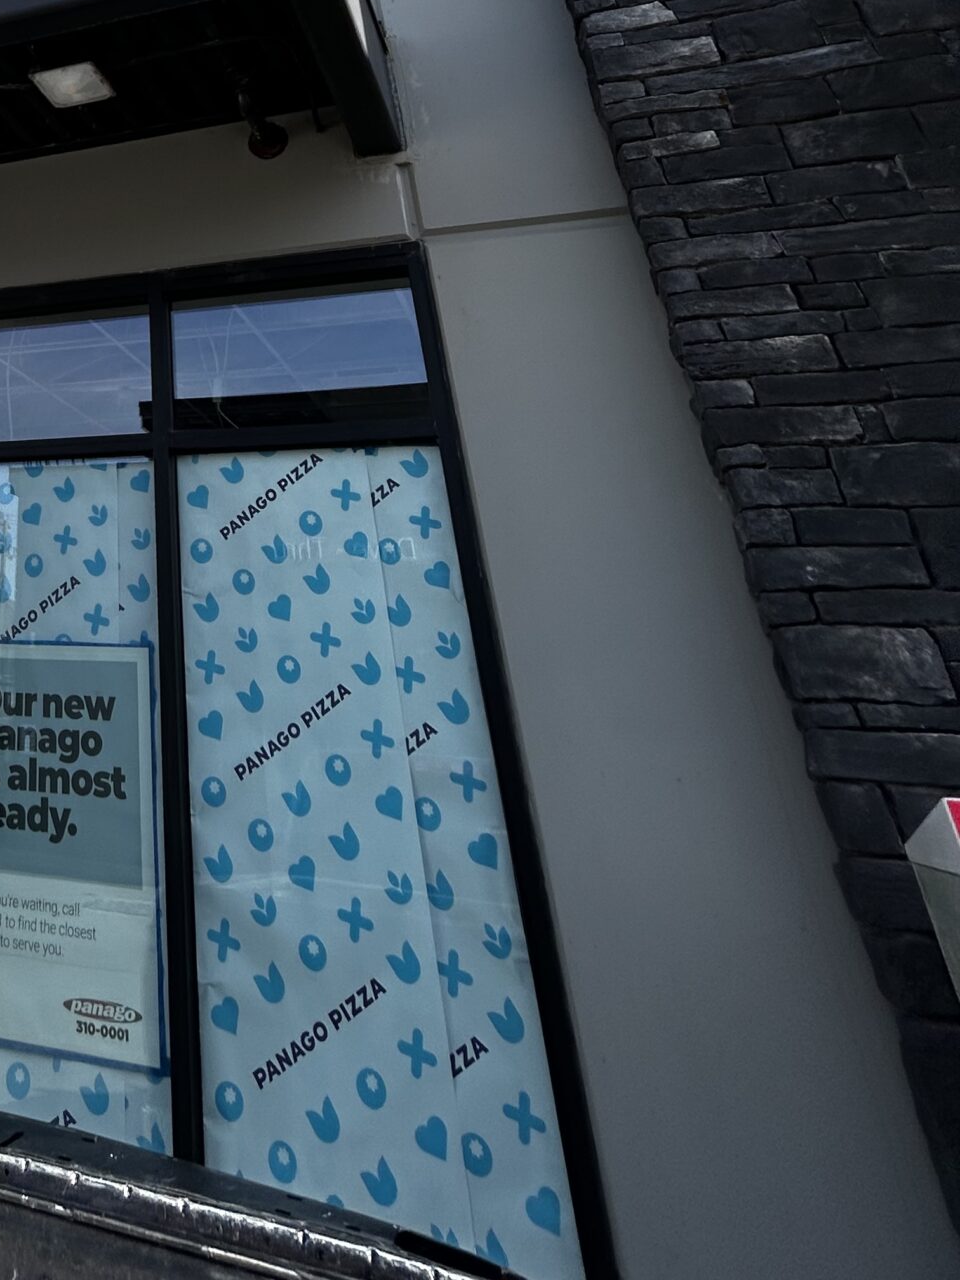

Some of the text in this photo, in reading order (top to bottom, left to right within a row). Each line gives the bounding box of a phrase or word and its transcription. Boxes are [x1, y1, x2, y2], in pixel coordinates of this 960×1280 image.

[220, 453, 324, 540] PANAGO PIZZA
[39, 576, 81, 614] PIZZA
[42, 692, 116, 722] new
[234, 683, 352, 781] PANAGO PIZZA
[7, 757, 127, 800] almost
[21, 899, 60, 917] waiting,
[62, 902, 81, 917] call
[5, 916, 16, 928] to
[18, 916, 37, 932] find
[40, 920, 56, 935] the
[58, 923, 96, 941] closest
[0, 935, 10, 948] to
[12, 938, 40, 952] serve
[42, 943, 64, 957] you.
[70, 998, 136, 1022] panago
[76, 1020, 129, 1042] 310-0001
[252, 978, 387, 1090] PANAGO PIZZA
